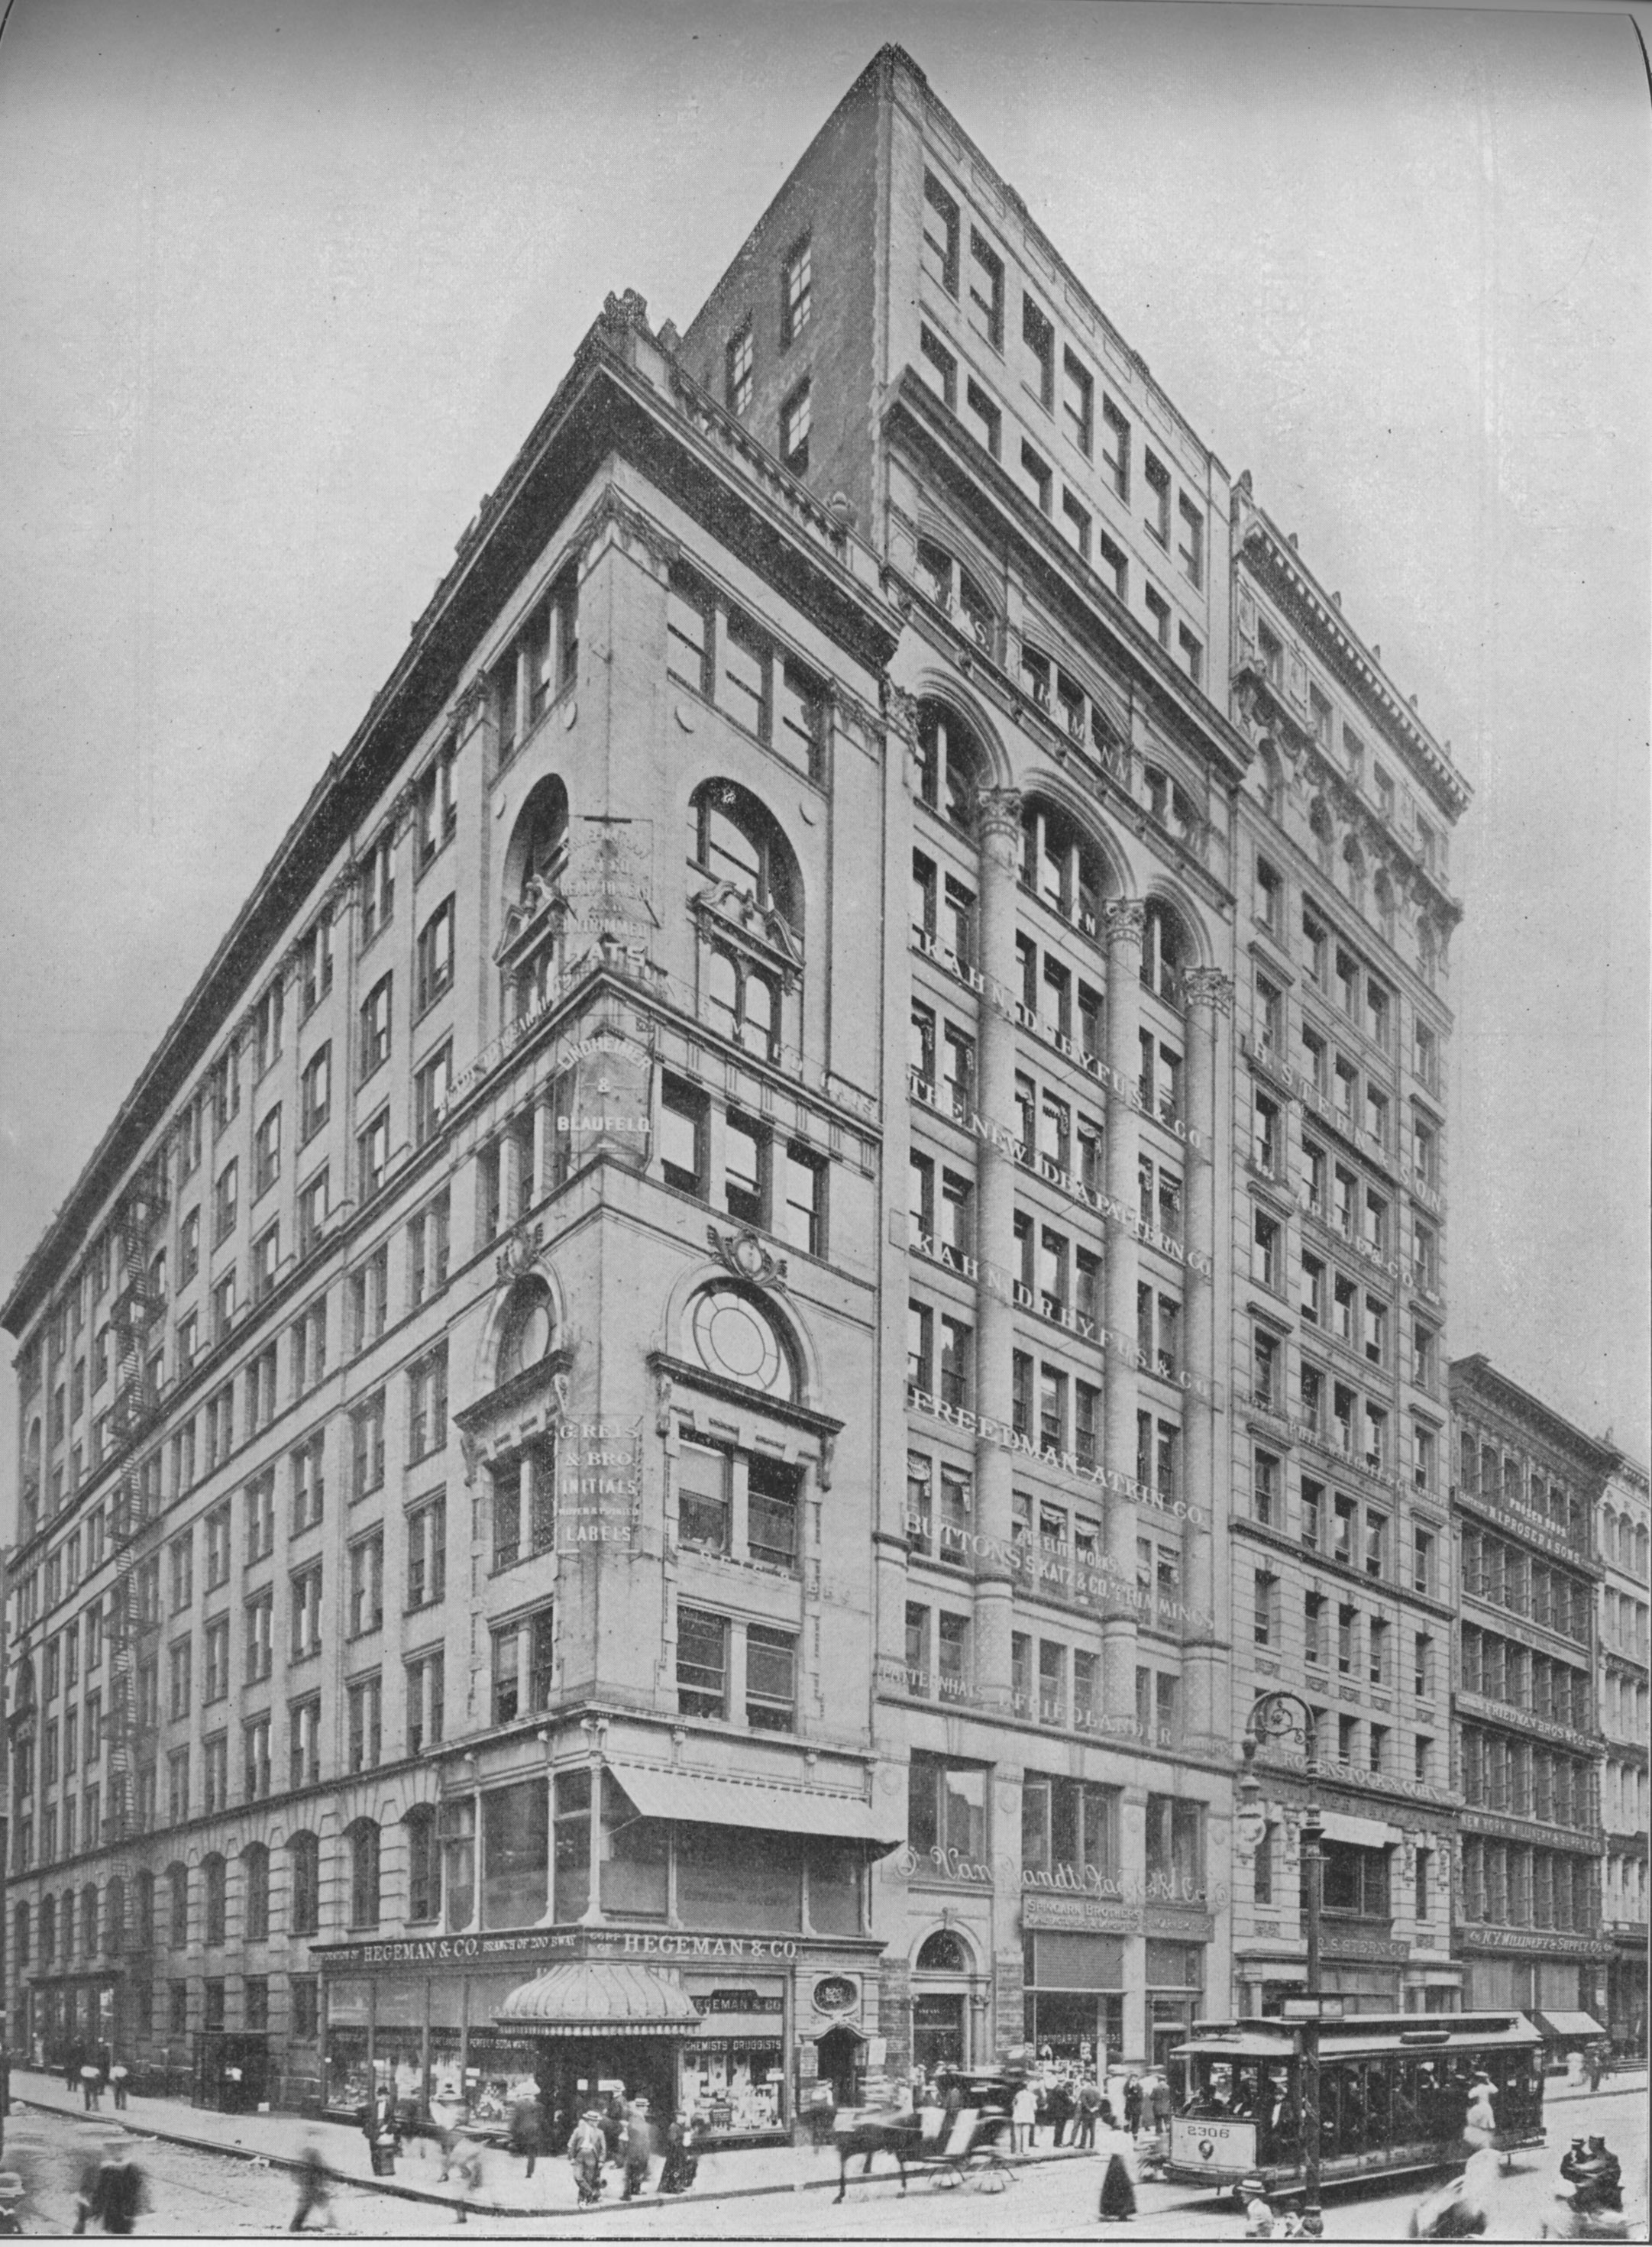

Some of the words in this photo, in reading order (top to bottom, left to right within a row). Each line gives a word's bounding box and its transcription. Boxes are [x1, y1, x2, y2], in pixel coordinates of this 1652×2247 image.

[597, 1077, 609, 1093] &
[566, 1452, 580, 1467] &
[561, 1478, 637, 1495] INITIALS
[566, 1526, 632, 1542] LABELS
[1284, 1753, 1385, 1789] ROENSTOCK
[929, 1845, 994, 1882] Van
[364, 1941, 436, 1962] HEGEMAN
[438, 1941, 451, 1958] &
[454, 1938, 480, 1957] CO.
[622, 1933, 744, 1957] HEGEMAN
[751, 1940, 767, 1957] &
[770, 1941, 800, 1959] CO.
[692, 1998, 748, 2012] EGEMAN
[685, 2040, 728, 2052] CHEMISTS
[1187, 2126, 1230, 2139] 2306
